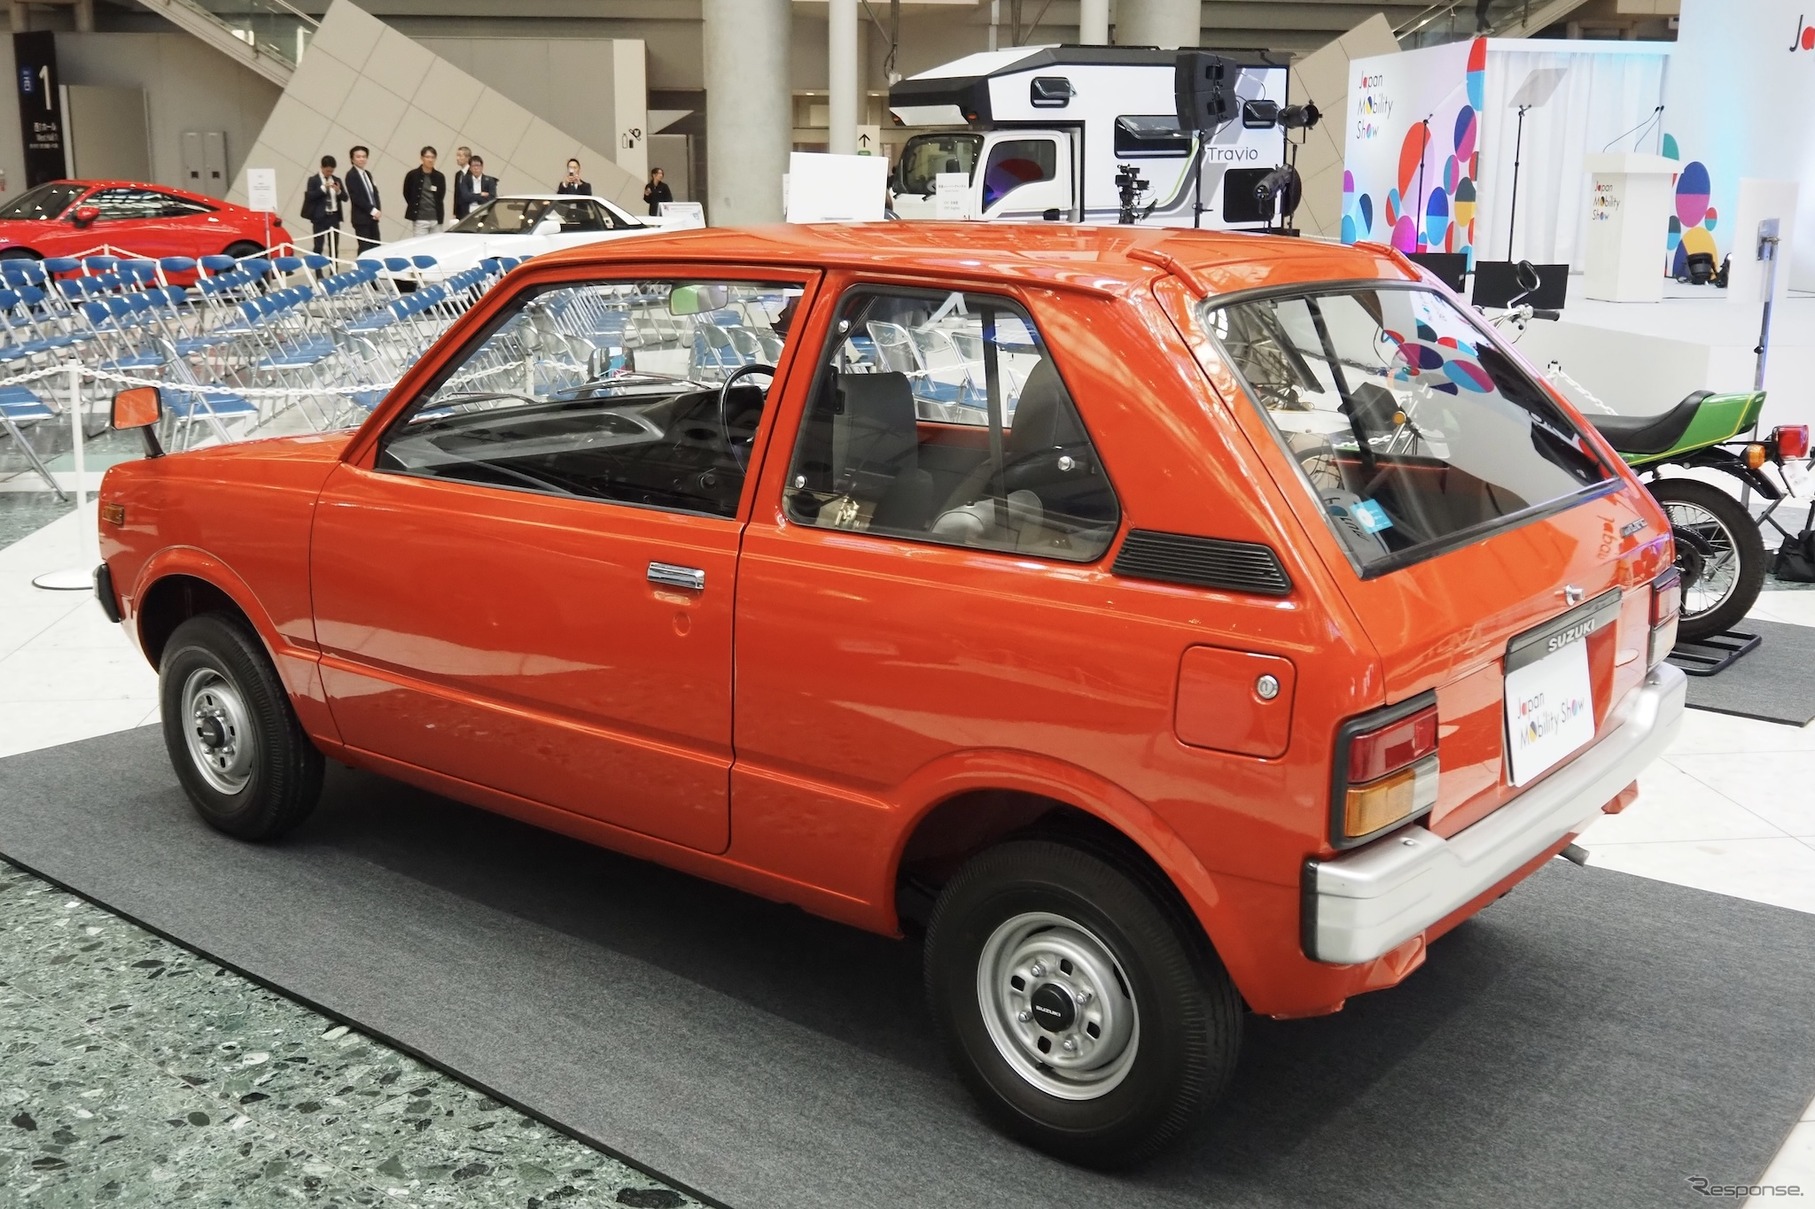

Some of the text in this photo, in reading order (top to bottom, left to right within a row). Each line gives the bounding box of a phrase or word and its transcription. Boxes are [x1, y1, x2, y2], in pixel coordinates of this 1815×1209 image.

[38, 65, 52, 110] 1
[1359, 71, 1383, 94] Japan
[1357, 93, 1393, 119] Mobility
[1356, 119, 1379, 139] Show
[1207, 147, 1259, 161] Travio
[1594, 180, 1613, 195] Japan
[1592, 208, 1610, 221] Show
[1593, 195, 1621, 211] Mobility
[1548, 619, 1595, 652] SUZUKI
[1517, 692, 1544, 720] Japan
[1520, 697, 1584, 750] Mobility Show
